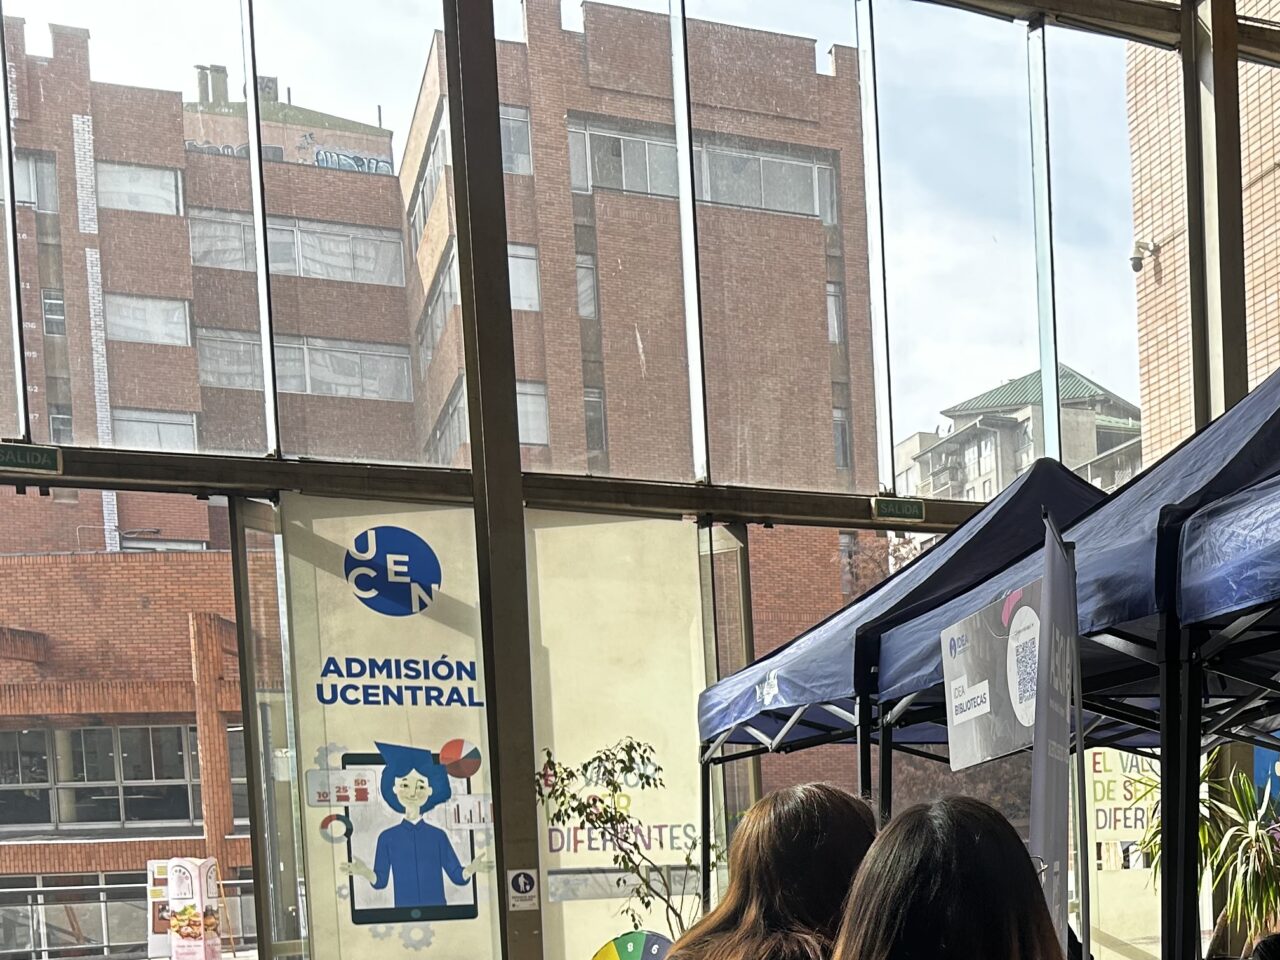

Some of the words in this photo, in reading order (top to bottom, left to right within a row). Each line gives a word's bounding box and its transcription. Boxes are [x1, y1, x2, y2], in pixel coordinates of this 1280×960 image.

[881, 503, 919, 515] SALIDA
[320, 654, 477, 681] ADMISIÓN
[316, 683, 485, 707] UCENTRAL
[953, 685, 965, 699] IDEA
[954, 692, 987, 715] BIBLIOTECAS
[1092, 751, 1112, 773] EL
[1119, 752, 1154, 773] VAL
[1093, 780, 1117, 802] DE
[1096, 806, 1149, 830] DIFER
[627, 942, 634, 952] 8
